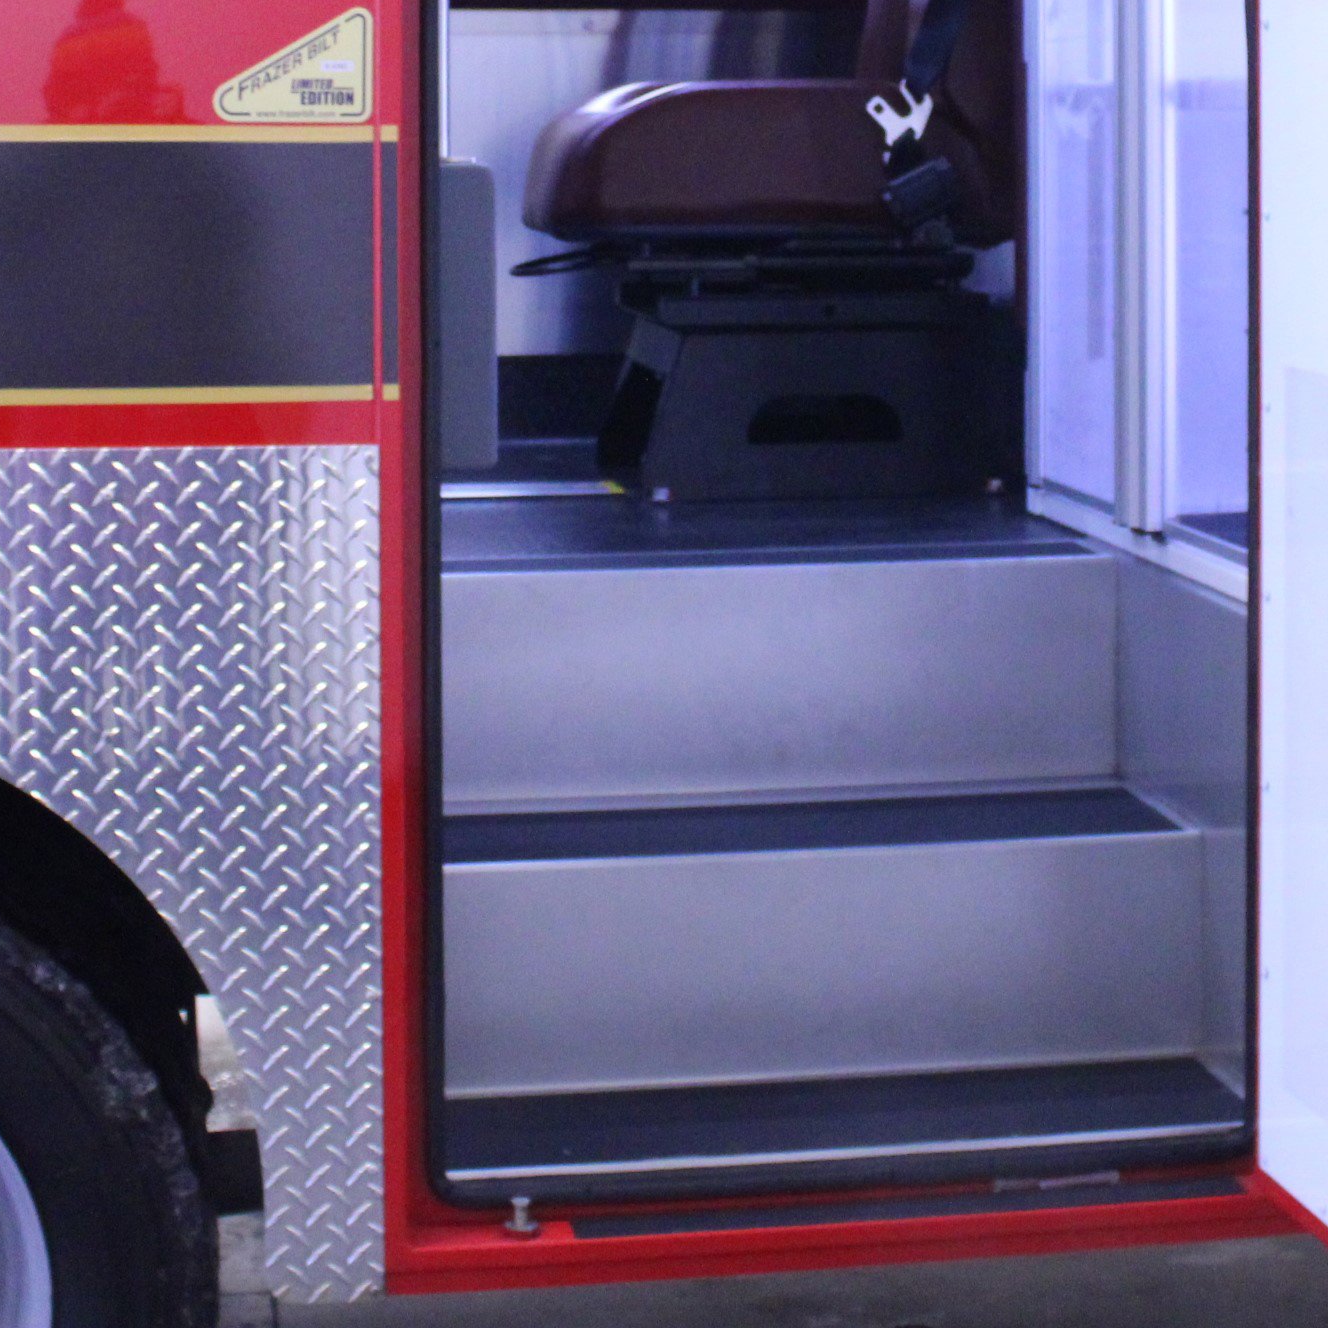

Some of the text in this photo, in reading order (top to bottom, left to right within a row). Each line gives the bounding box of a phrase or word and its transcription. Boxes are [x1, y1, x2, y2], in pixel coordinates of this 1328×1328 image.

[238, 27, 341, 101] FRAZER BILT
[290, 78, 334, 91] LIMITED
[300, 90, 354, 106] EDITION
